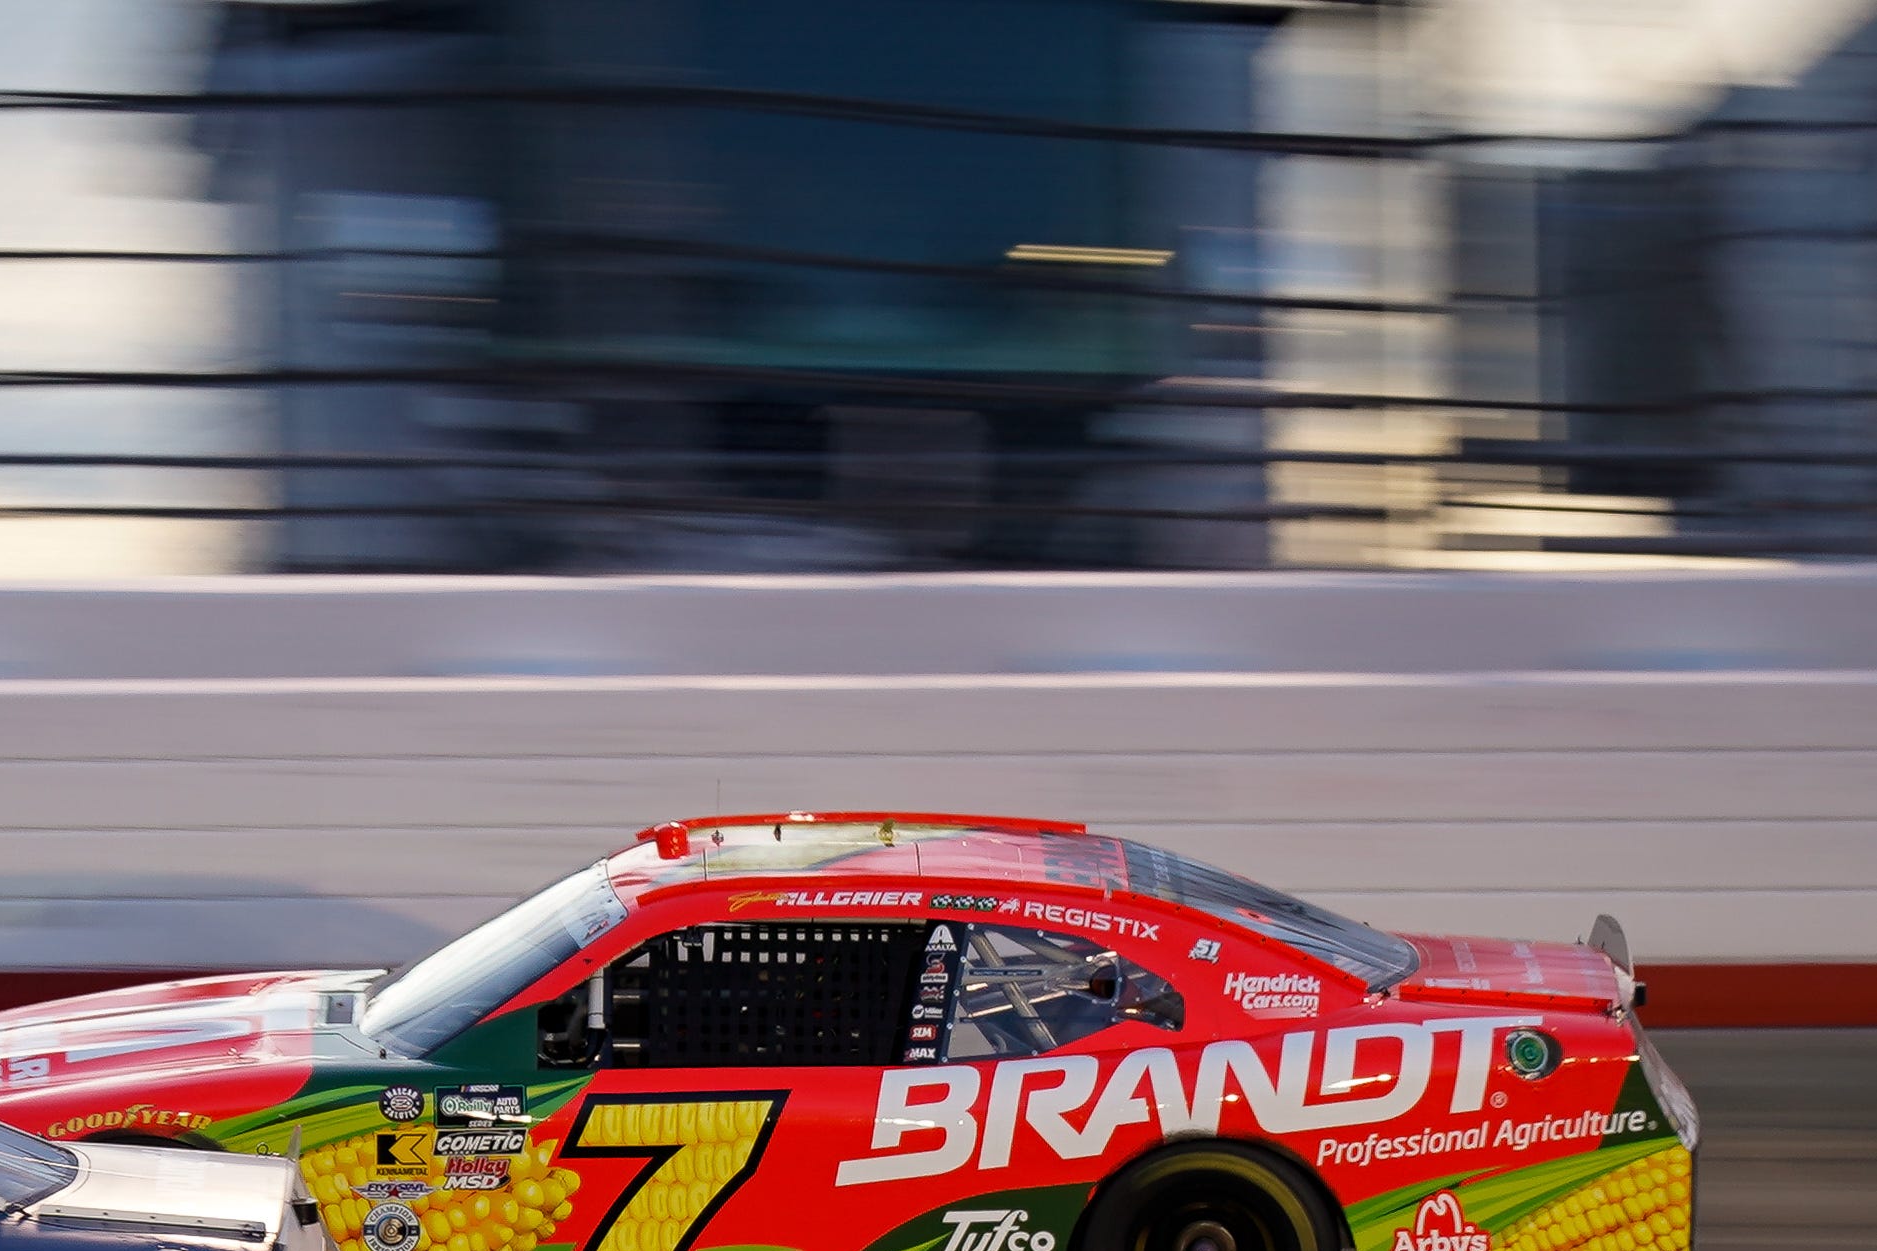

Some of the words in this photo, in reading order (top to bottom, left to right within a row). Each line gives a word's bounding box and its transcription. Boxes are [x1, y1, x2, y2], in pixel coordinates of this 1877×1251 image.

[1024, 901, 1160, 941] REGISTIX
[1225, 973, 1320, 1000] Hendrick
[1242, 993, 1320, 1010] Cars.com
[493, 1106, 521, 1115] PARTS
[496, 1097, 518, 1106] AUTO
[836, 1016, 1543, 1186] BRANDT
[437, 1135, 523, 1152] COMETIC
[1316, 1122, 1489, 1167] Professional
[1493, 1108, 1648, 1152] Agriculture
[445, 1157, 510, 1178] Holley
[443, 1176, 501, 1190] MSD
[369, 1204, 415, 1223] CHAMPION
